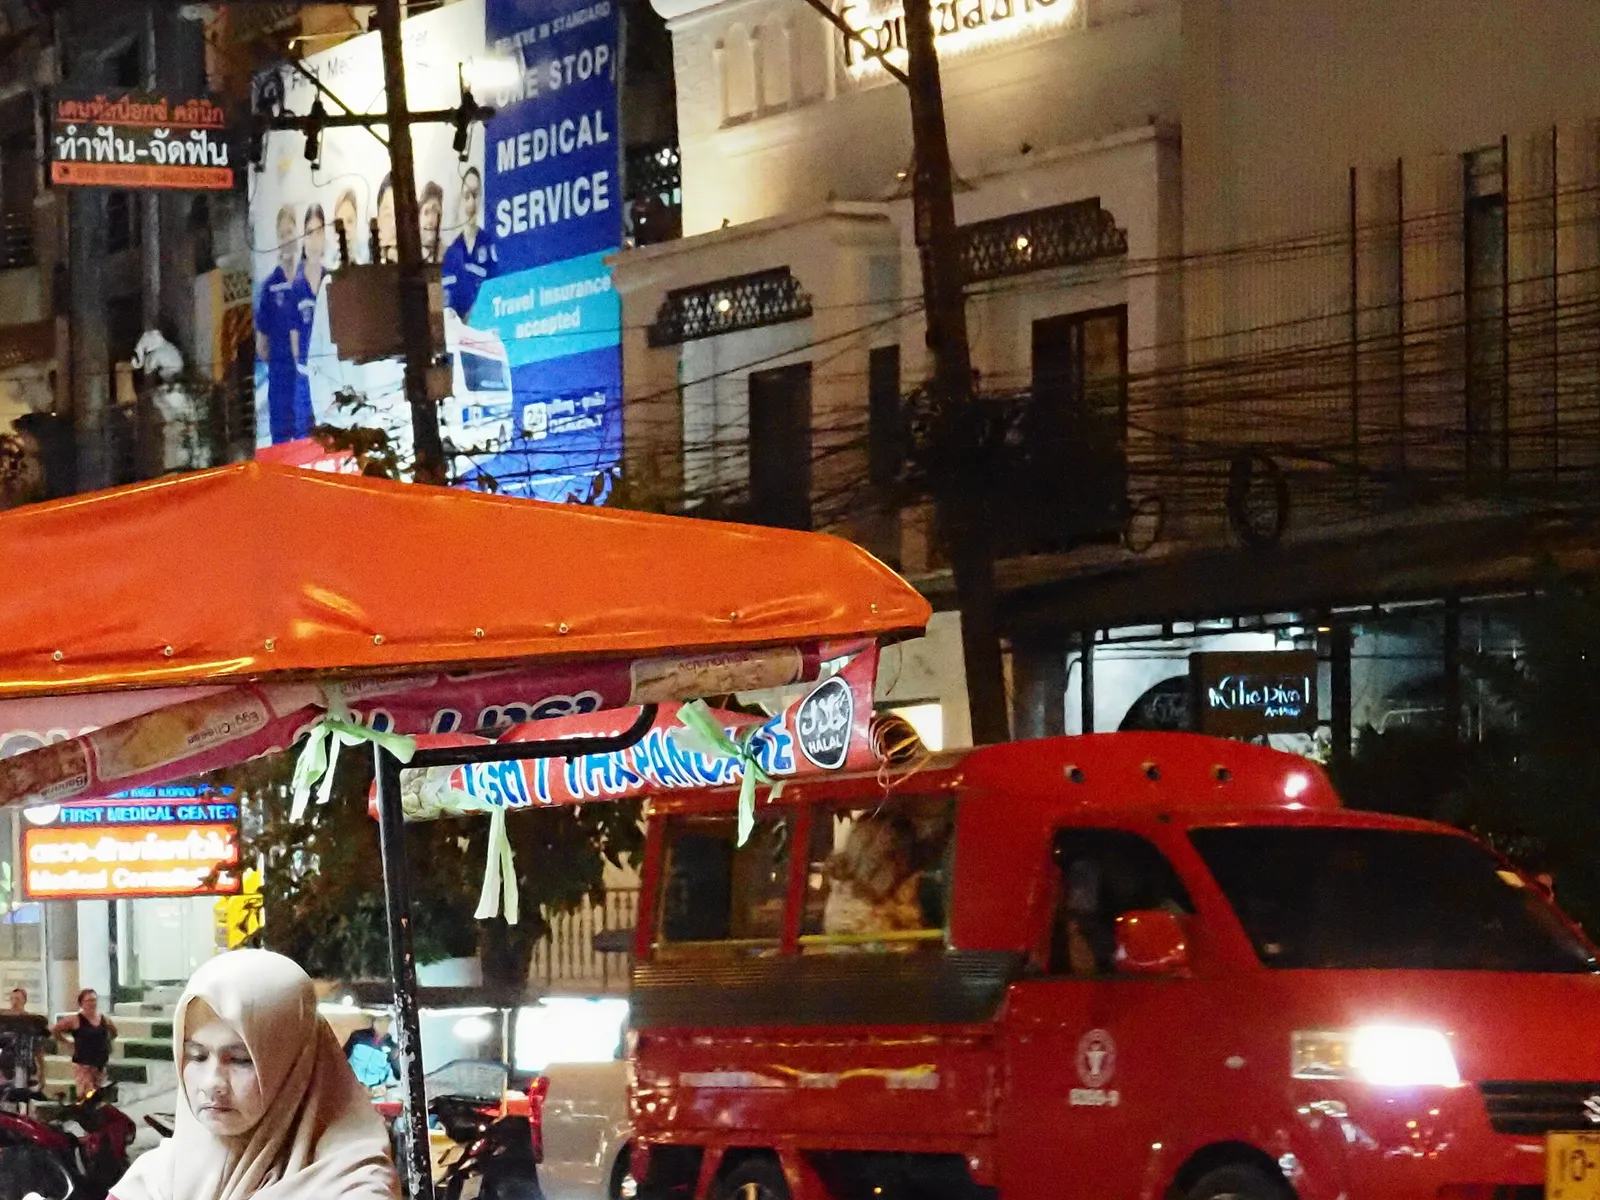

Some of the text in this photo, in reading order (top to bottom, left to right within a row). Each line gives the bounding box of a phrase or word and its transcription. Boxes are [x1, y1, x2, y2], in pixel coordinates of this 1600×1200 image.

[549, 43, 610, 90] STOP
[55, 124, 229, 167] ทำฟัน-จัดฟัน
[497, 110, 609, 173] MEDICAL
[496, 171, 610, 238] SERVICE
[492, 287, 535, 318] Travel
[807, 734, 843, 754] HALAL
[60, 806, 104, 823] FIRST
[106, 804, 177, 821] MEDICAL
